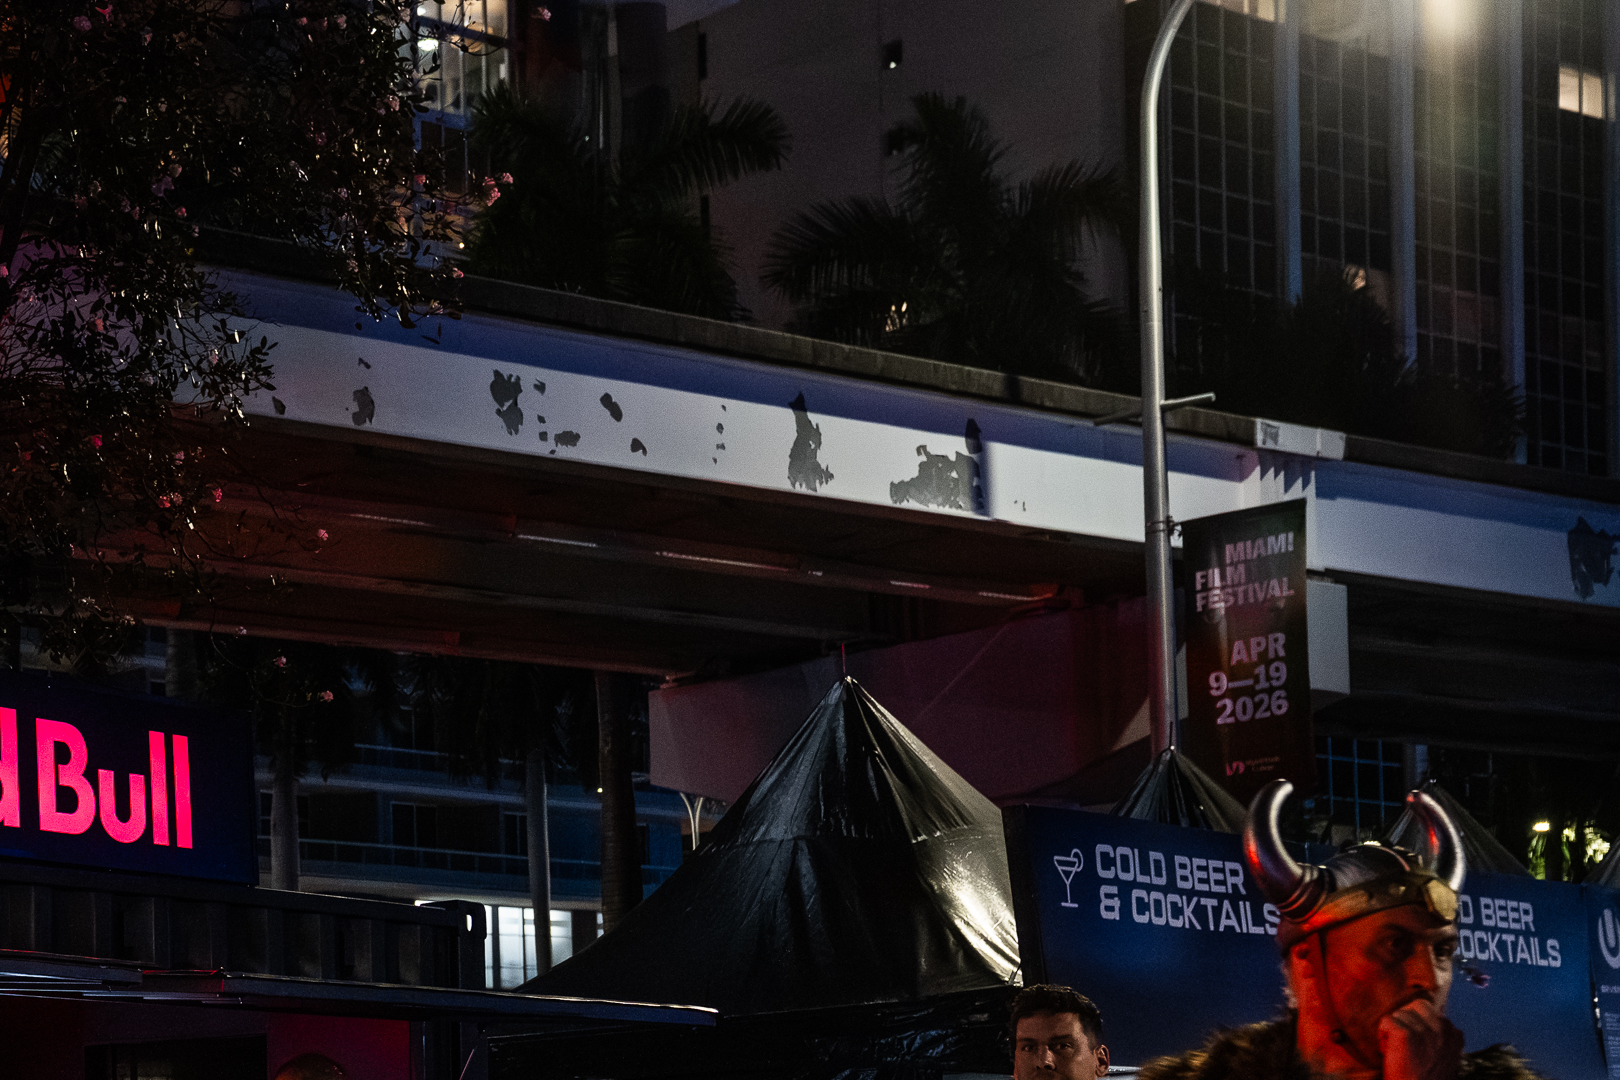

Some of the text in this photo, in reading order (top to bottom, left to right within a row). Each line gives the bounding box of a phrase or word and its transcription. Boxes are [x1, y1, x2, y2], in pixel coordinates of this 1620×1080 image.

[1225, 531, 1294, 565] MIAMI
[1195, 563, 1246, 592] FILM
[1196, 576, 1295, 613] FESTIVAL
[1231, 633, 1286, 666] APR
[1216, 689, 1289, 725] 2026
[35, 717, 193, 850] Bull
[1095, 843, 1247, 895] COLD BEER
[1099, 884, 1281, 936] & COCKTAILS
[1479, 897, 1536, 932] BEER
[1453, 928, 1562, 968] OCKTAILS
